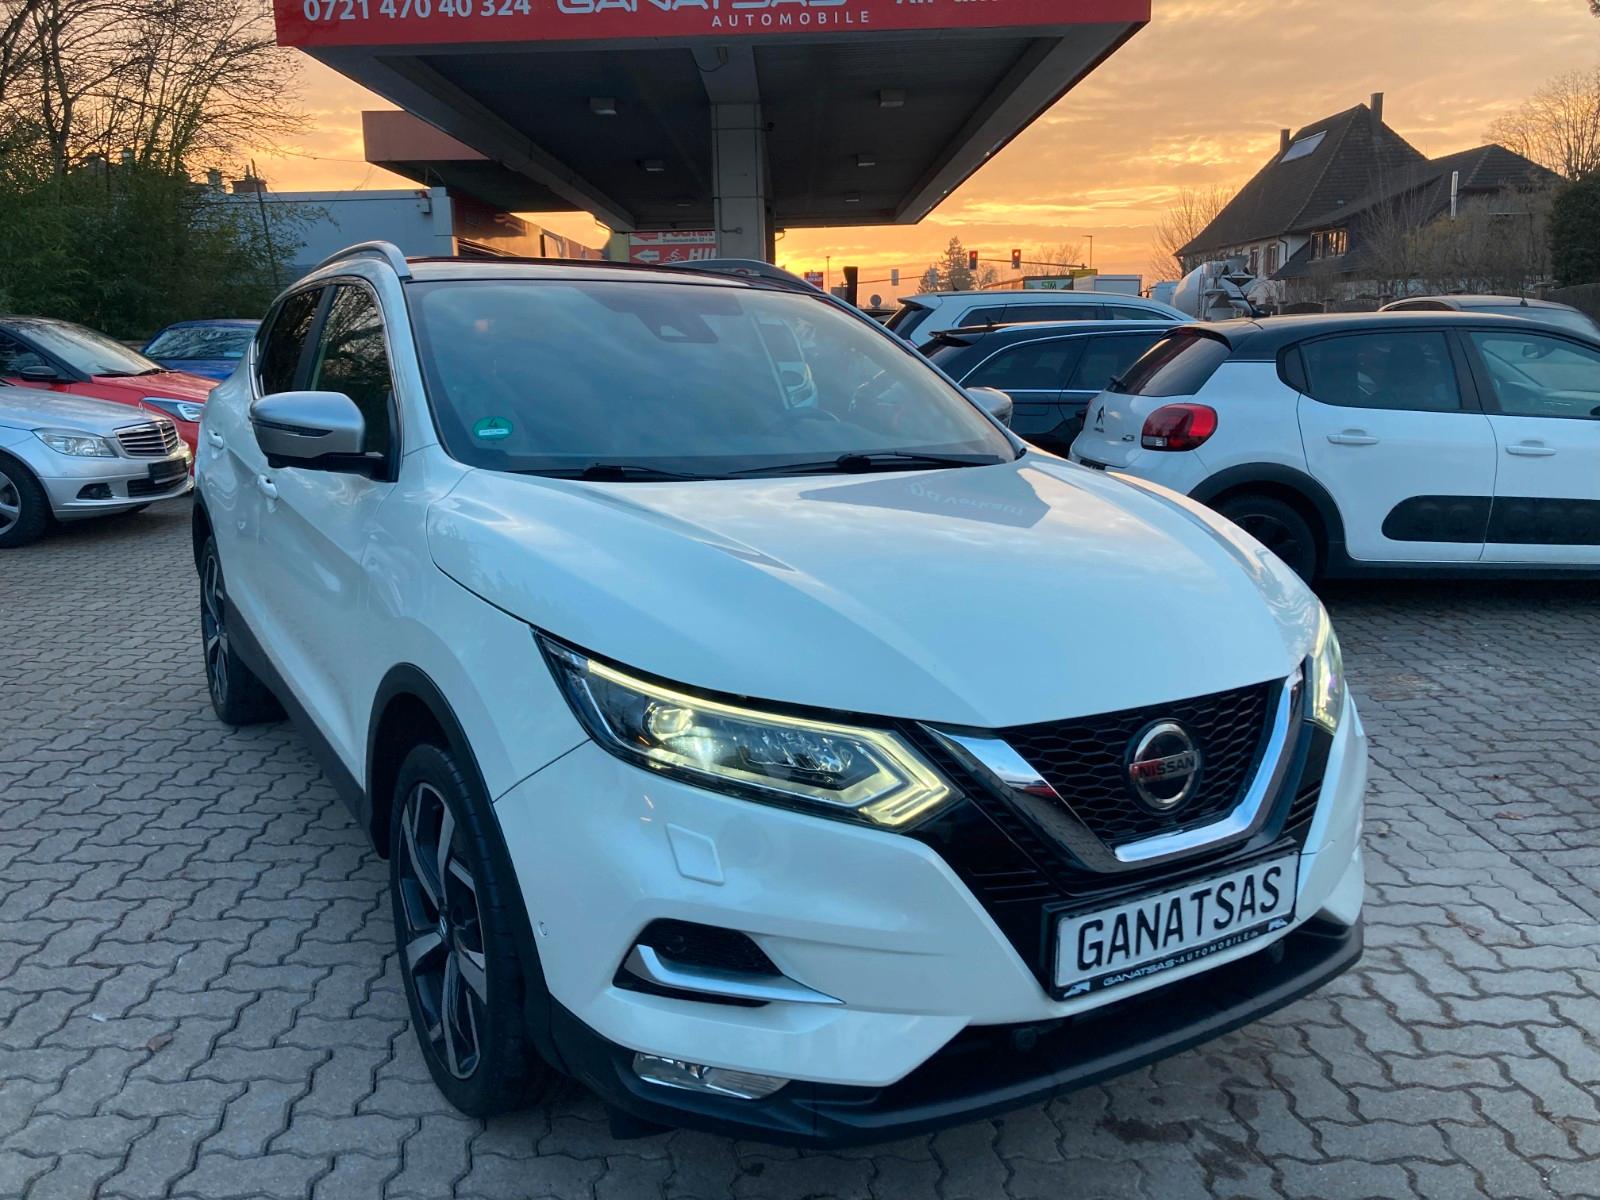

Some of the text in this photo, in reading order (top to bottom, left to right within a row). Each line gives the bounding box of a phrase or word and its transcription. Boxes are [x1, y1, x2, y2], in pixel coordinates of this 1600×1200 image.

[303, 0, 532, 21] 0721 470 40 324
[711, 11, 869, 27] AUTOMOBILE
[1140, 756, 1195, 777] NISSAN
[1076, 866, 1282, 971] GANATSAS
